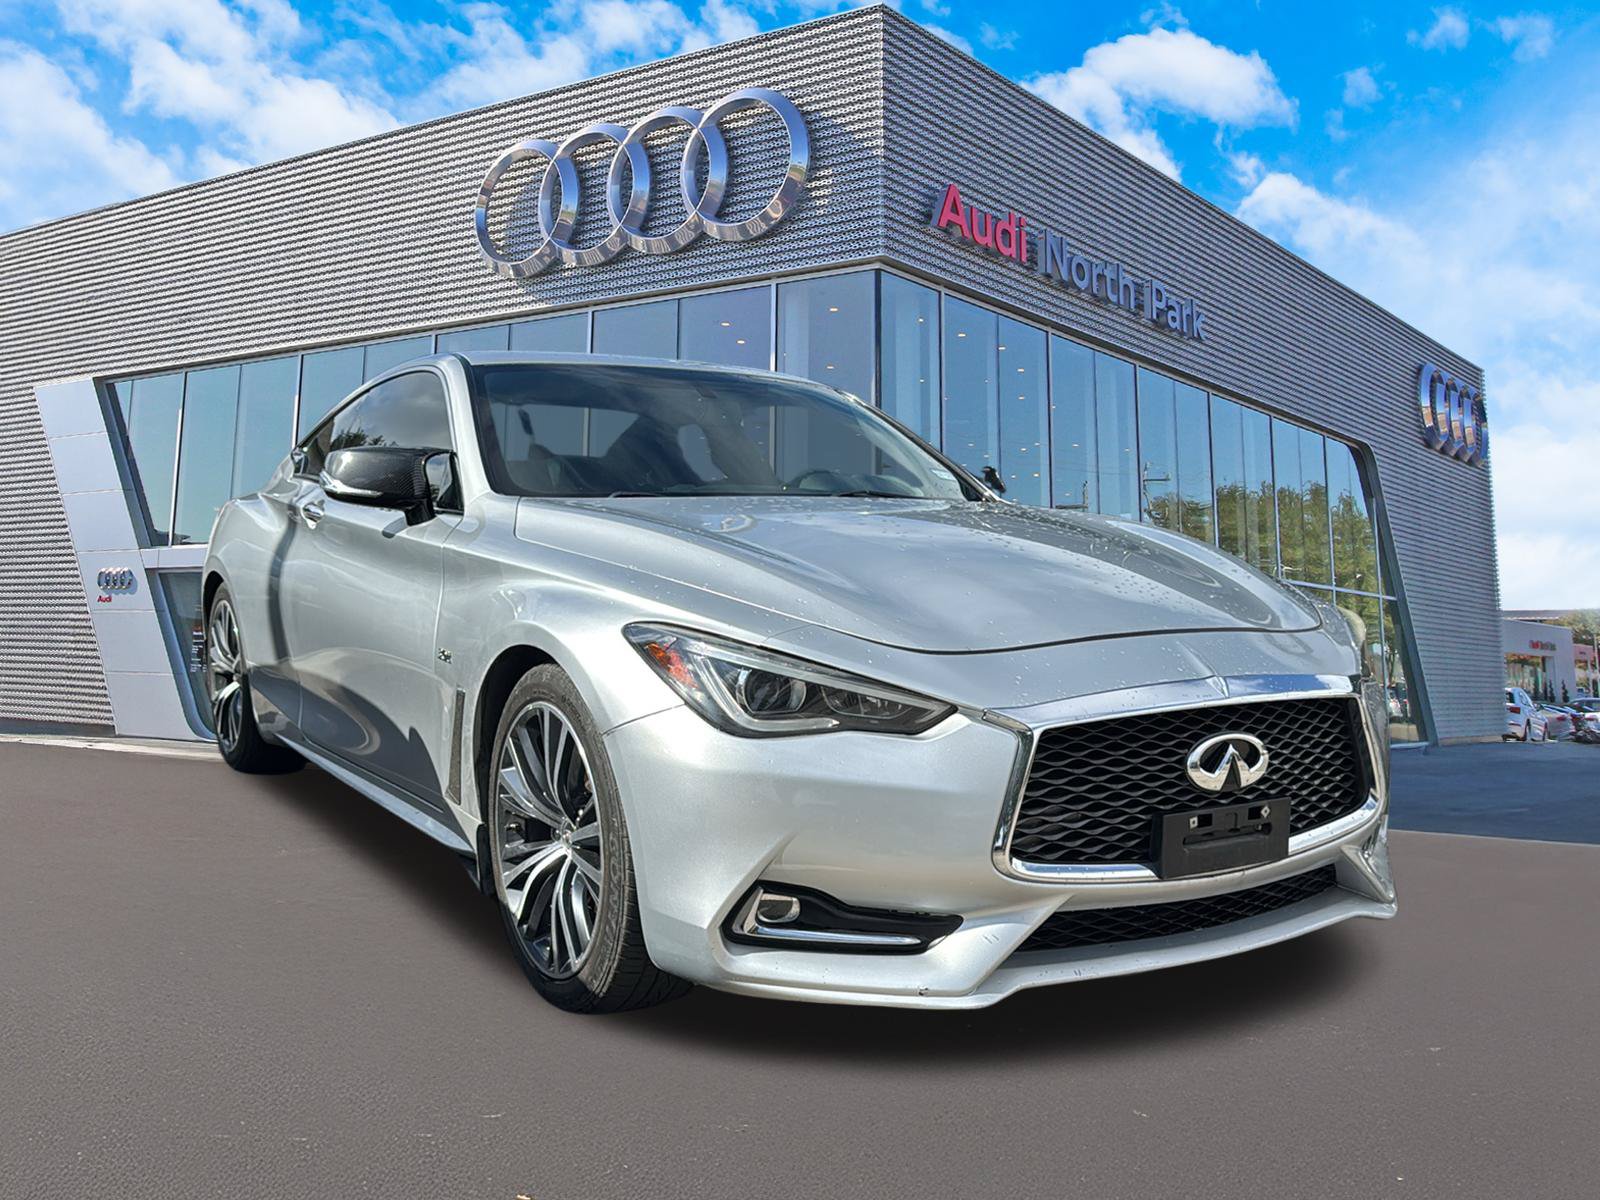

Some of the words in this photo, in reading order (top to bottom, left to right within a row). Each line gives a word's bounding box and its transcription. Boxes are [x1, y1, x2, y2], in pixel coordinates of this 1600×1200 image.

[935, 183, 1027, 264] Audi
[1041, 229, 1136, 310] North
[1149, 278, 1207, 340] Park
